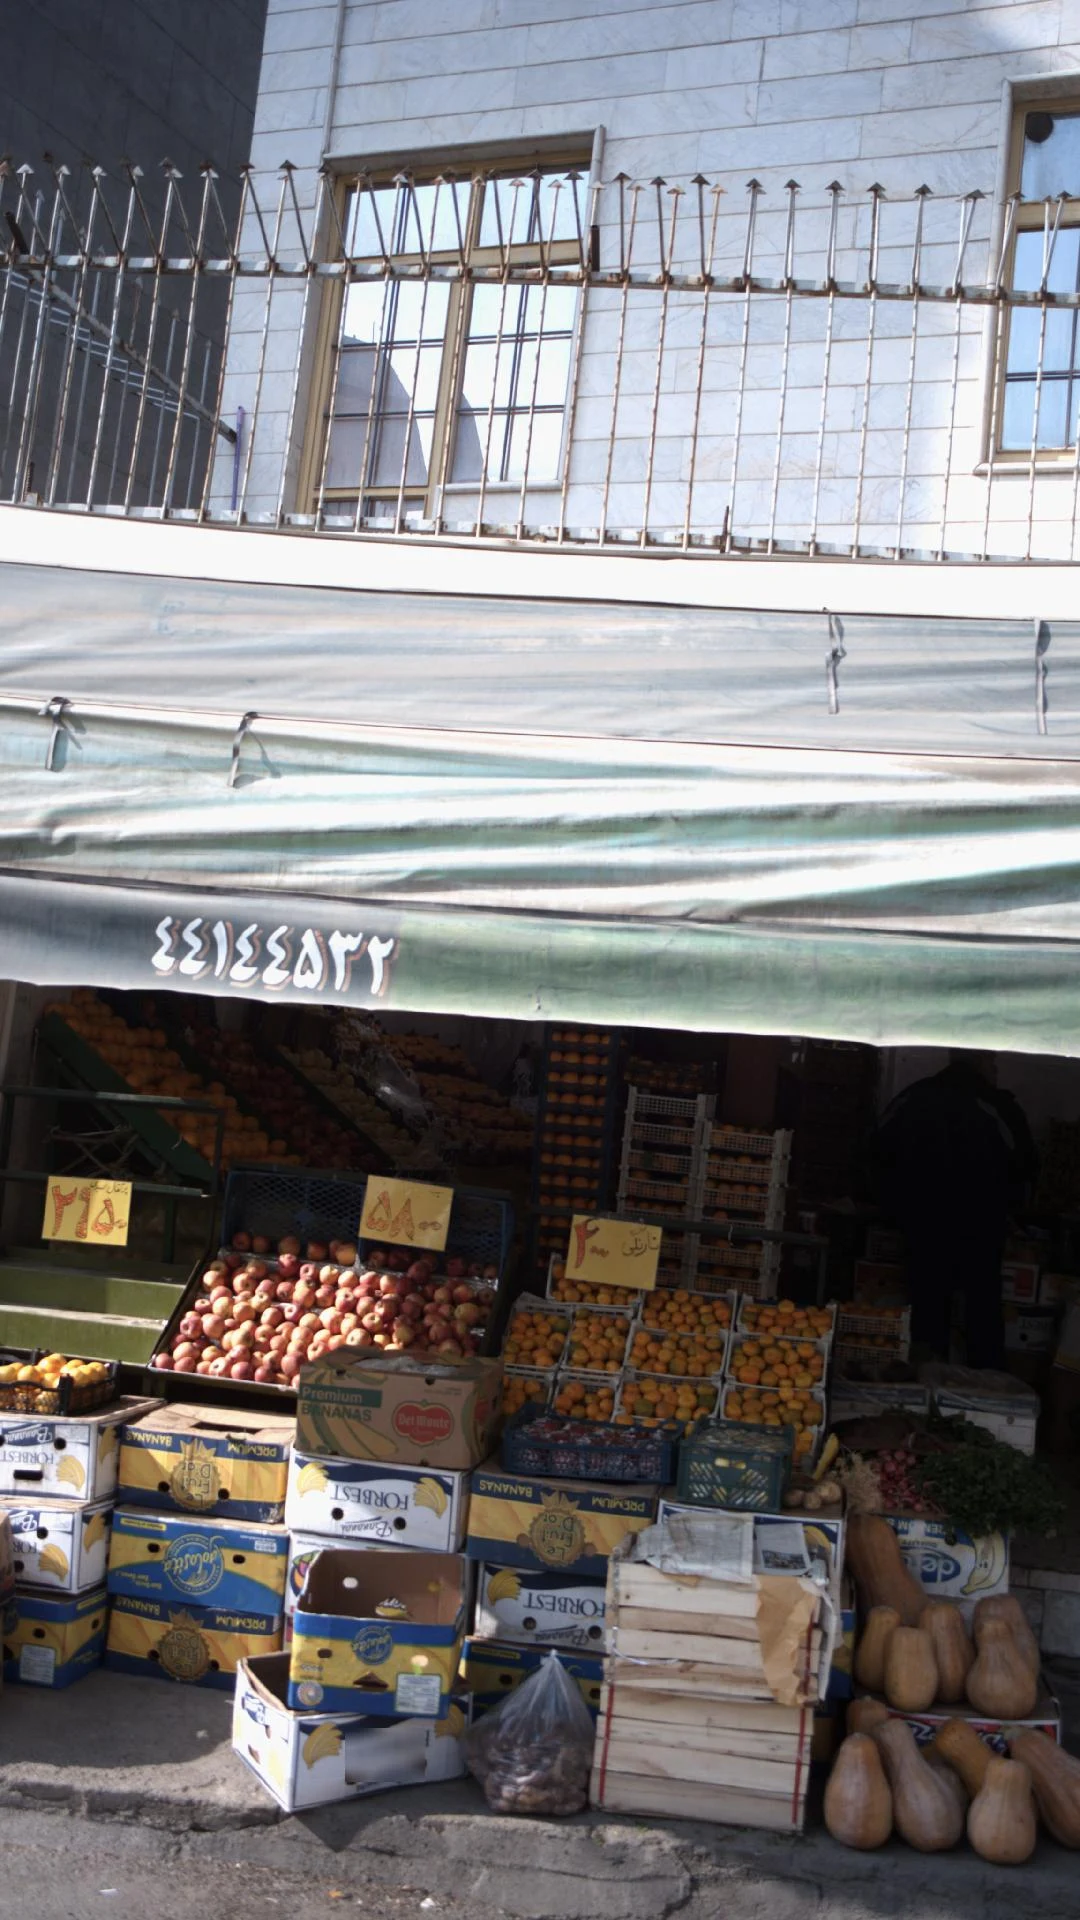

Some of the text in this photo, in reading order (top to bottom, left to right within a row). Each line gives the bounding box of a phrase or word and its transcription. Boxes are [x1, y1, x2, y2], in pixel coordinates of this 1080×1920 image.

[302, 1386, 362, 1404] Premium
[126, 1429, 277, 1458] PREMIUM BANANAS
[329, 1483, 409, 1511] FORBEST
[479, 1479, 646, 1513] PREMIUM BANANAS
[339, 1518, 393, 1537] Bananas
[546, 1545, 566, 1561] Le
[522, 1592, 606, 1618] FORBEST
[215, 1615, 267, 1631] PREMIUM
